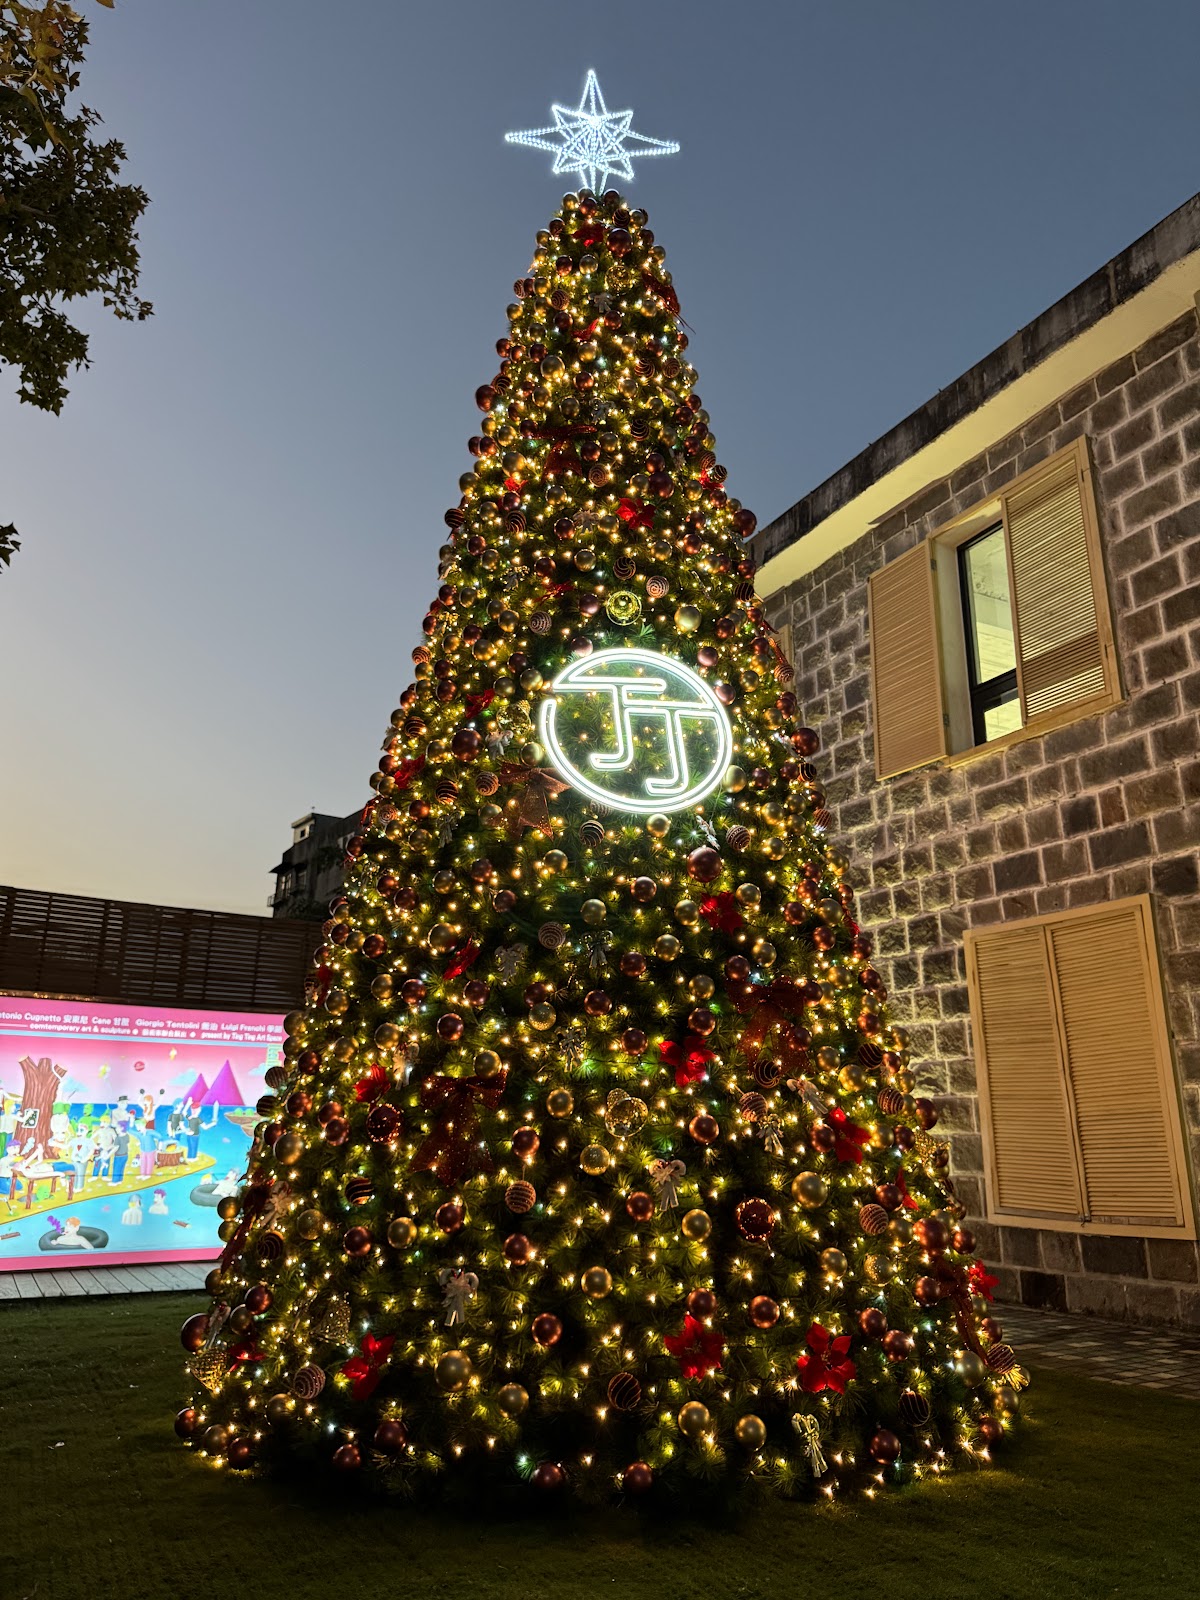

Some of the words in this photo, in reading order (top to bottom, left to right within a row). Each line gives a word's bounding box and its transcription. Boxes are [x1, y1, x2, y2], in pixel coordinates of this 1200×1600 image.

[24, 1012, 62, 1022] Cugnetto
[135, 1018, 165, 1028] Giorgio
[220, 1022, 239, 1032] Luigi
